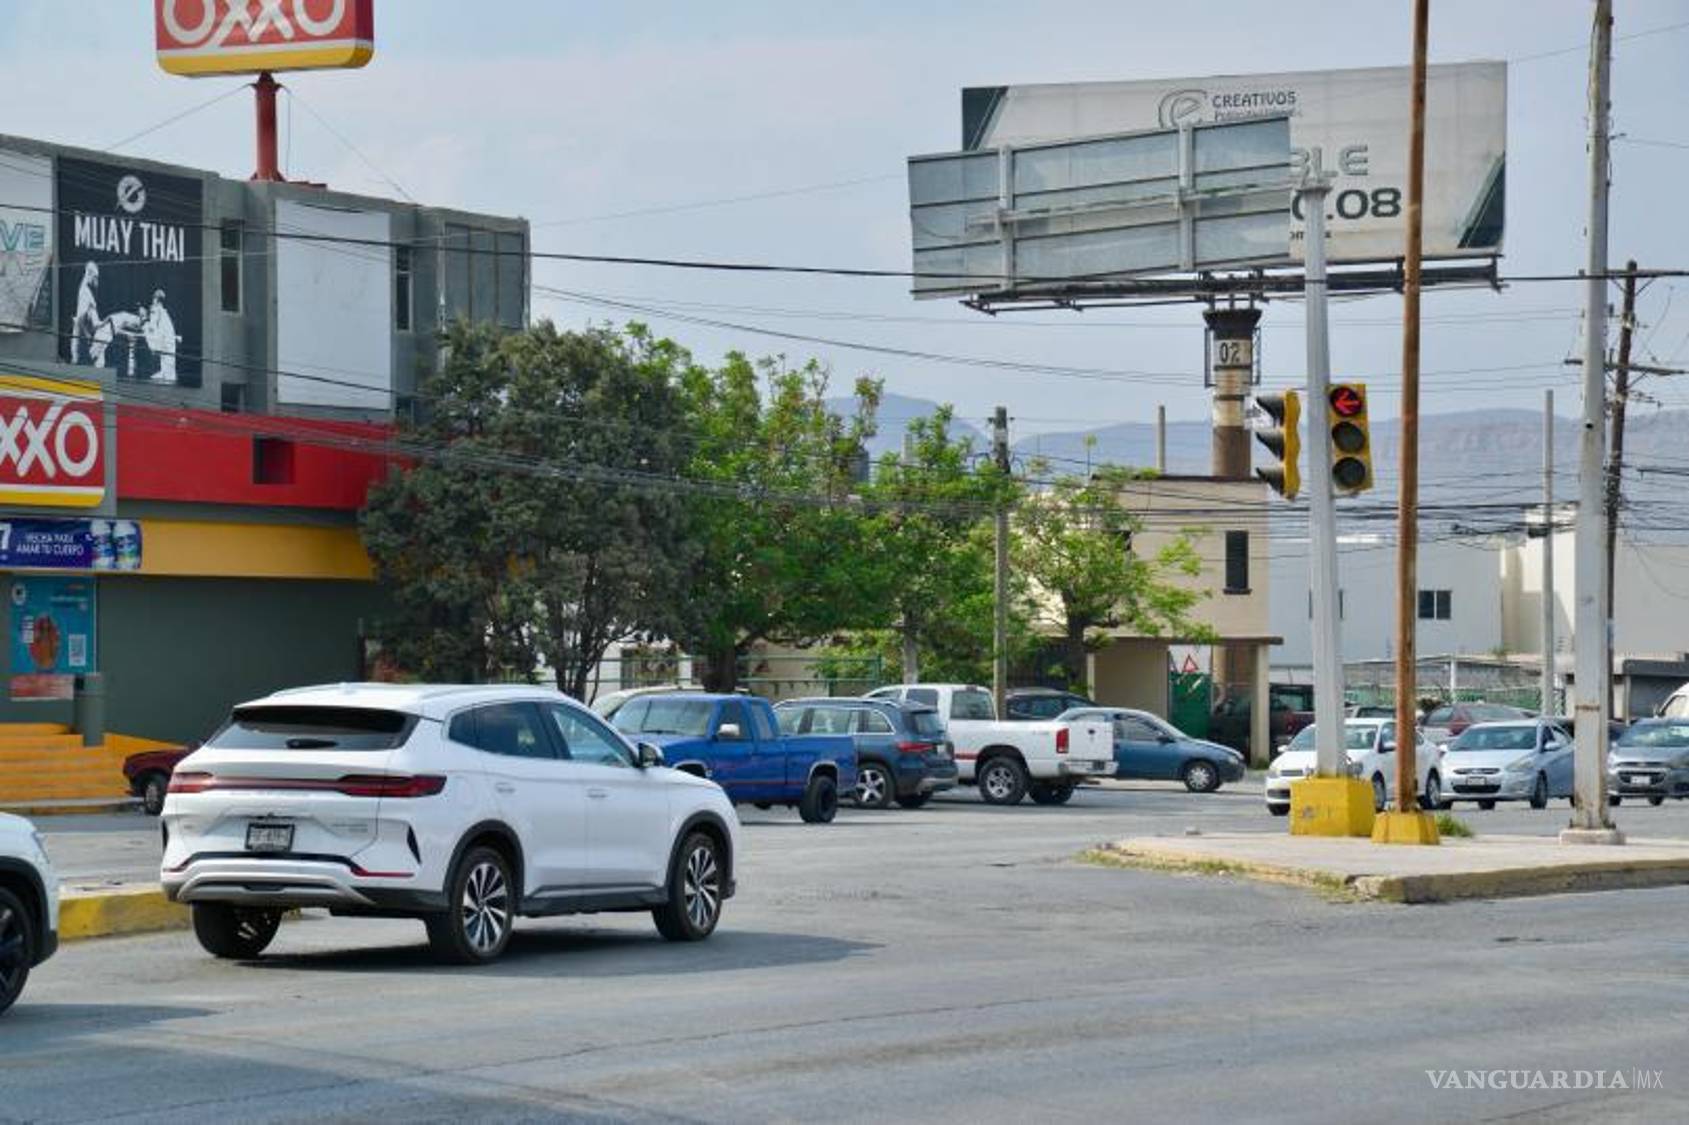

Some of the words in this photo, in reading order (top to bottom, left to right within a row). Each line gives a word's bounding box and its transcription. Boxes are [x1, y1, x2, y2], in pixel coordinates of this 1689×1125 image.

[1212, 91, 1297, 108] CREATIVOS
[75, 215, 134, 254] MUAY
[140, 222, 185, 262] THAI
